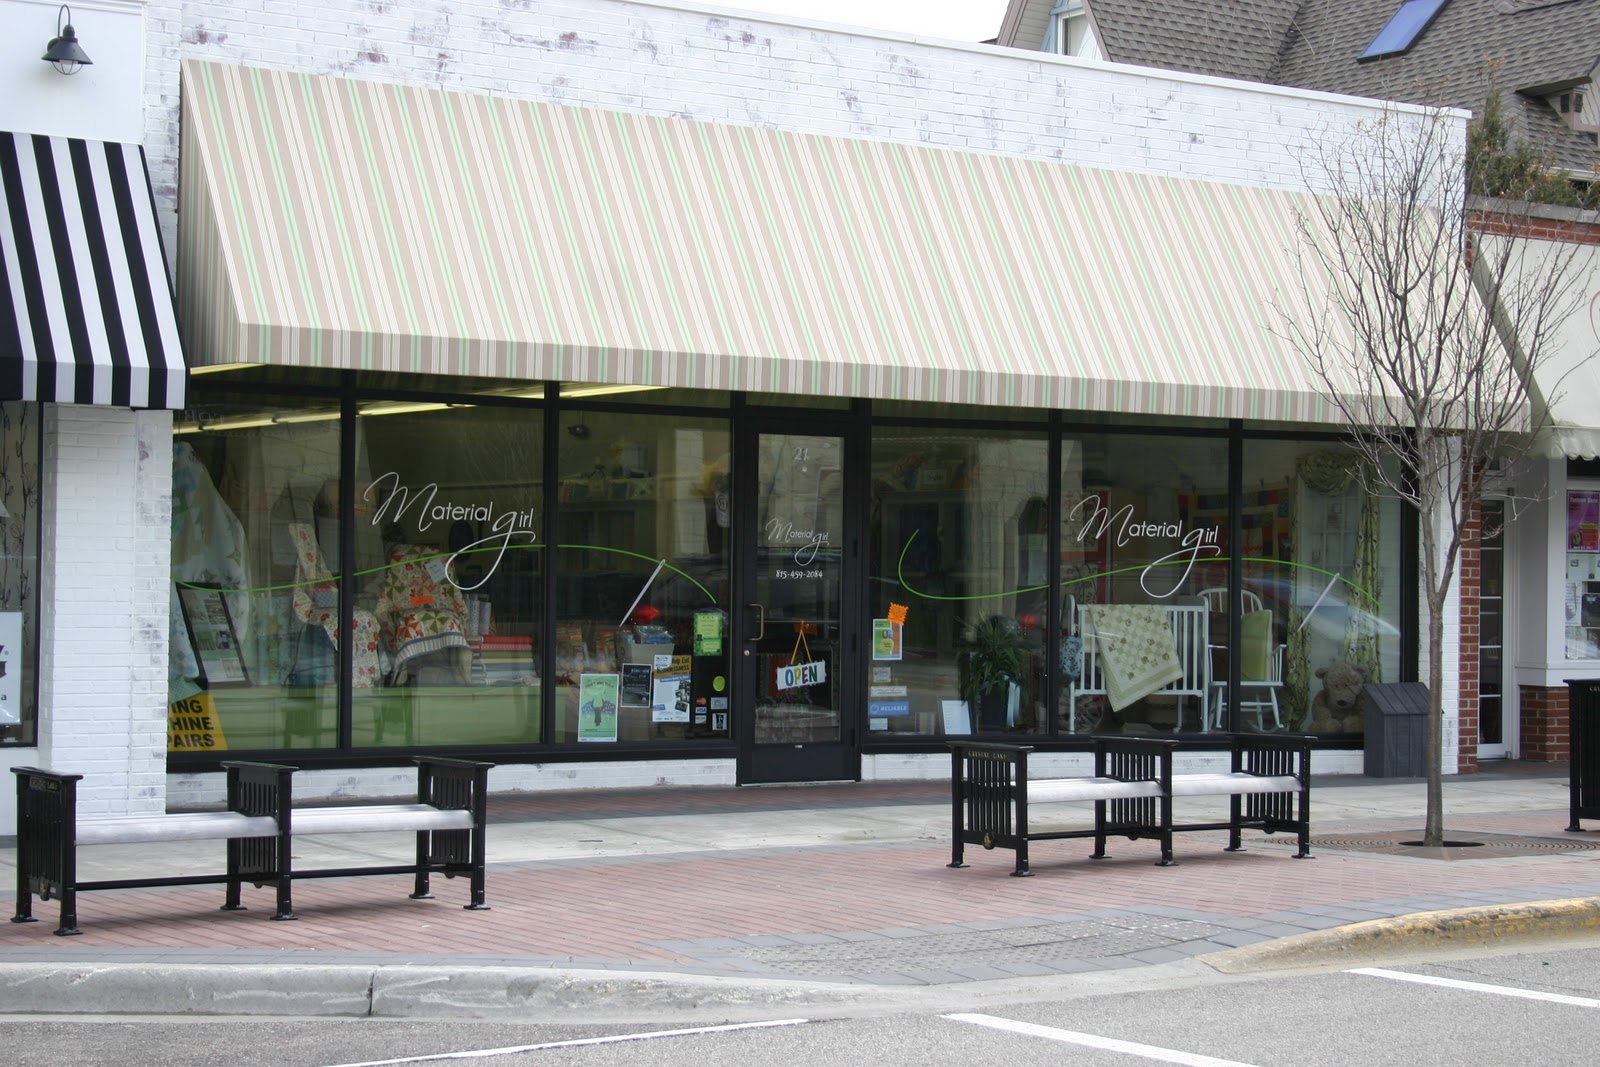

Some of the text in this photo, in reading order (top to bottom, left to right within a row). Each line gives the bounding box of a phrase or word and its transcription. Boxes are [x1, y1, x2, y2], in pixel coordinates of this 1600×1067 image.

[794, 446, 809, 460] 21
[363, 471, 536, 590] Material girl
[765, 518, 829, 566] Material girl
[1069, 494, 1221, 598] Material girl
[775, 569, 823, 579] 815-459-2084
[784, 664, 818, 687] OPEN
[880, 704, 908, 713] RELIABLE
